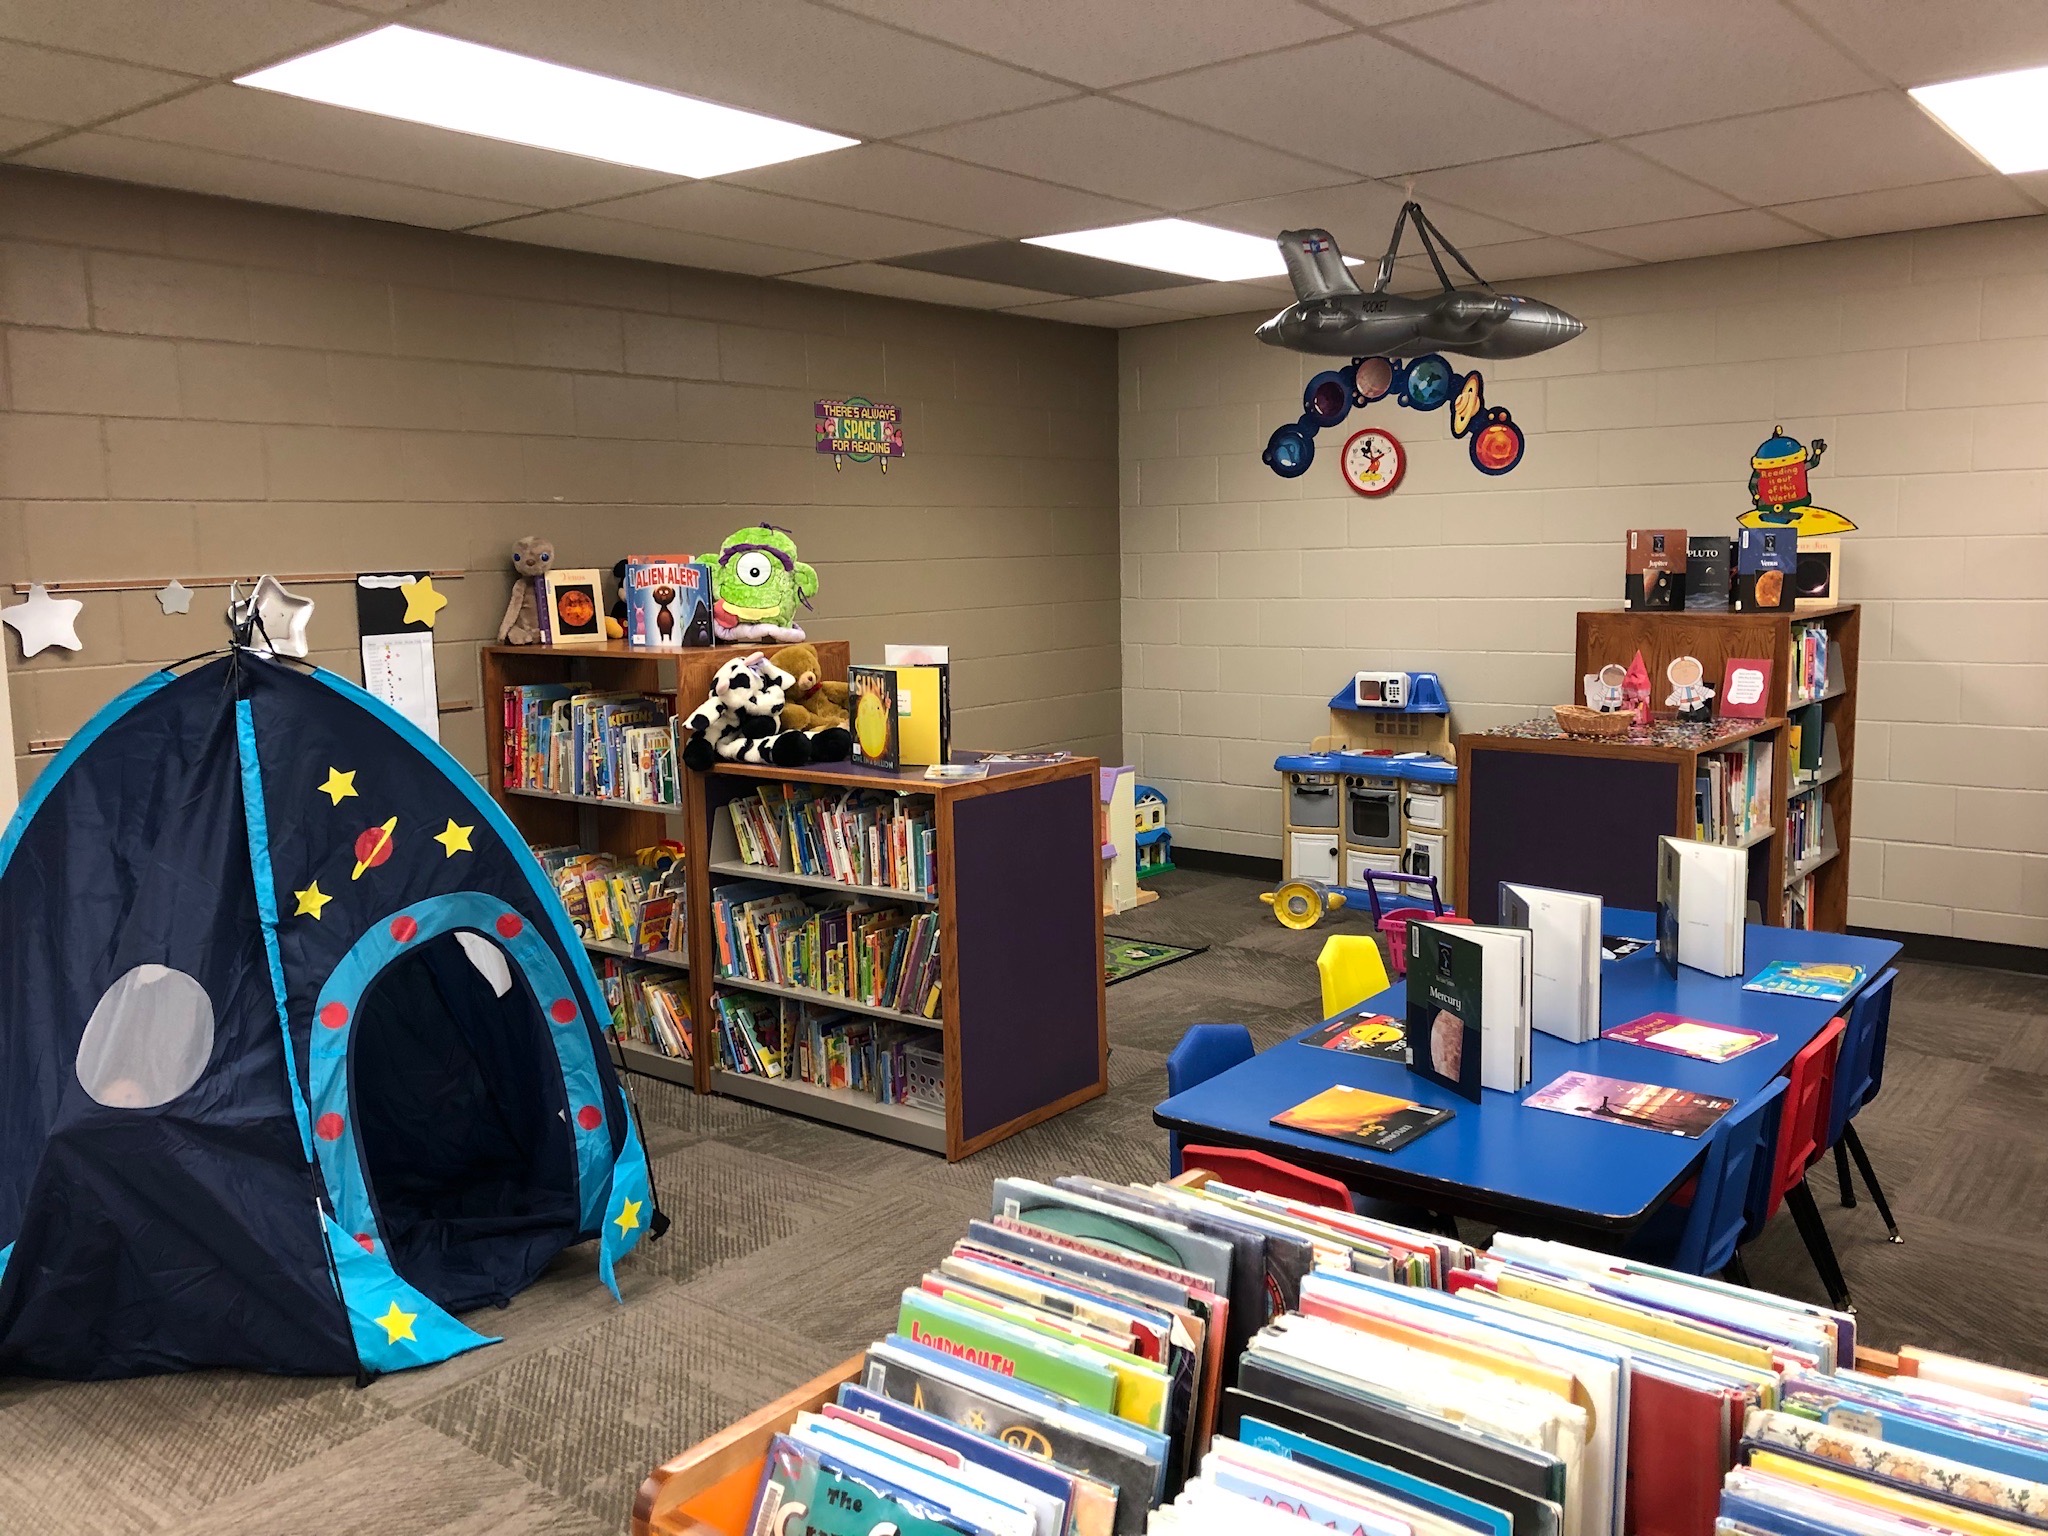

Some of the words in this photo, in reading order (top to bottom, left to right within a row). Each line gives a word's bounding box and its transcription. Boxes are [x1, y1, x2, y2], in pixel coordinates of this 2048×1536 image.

[823, 405, 860, 418] THERE'S
[861, 408, 896, 421] ALWAYS
[843, 419, 877, 440] SPACE
[832, 440, 850, 451] FOR
[851, 441, 891, 454] READING
[1761, 467, 1799, 478] Reading
[1776, 475, 1793, 484] out
[1768, 485, 1778, 494] of
[1779, 484, 1796, 493] this
[1768, 491, 1797, 502] World
[1687, 549, 1719, 558] PLUTO
[1648, 560, 1669, 568] Jupiter
[636, 567, 665, 589] ALIEN
[667, 567, 699, 588] ALERT
[855, 674, 885, 700] SUN!
[608, 710, 654, 728] KITTENS
[1429, 985, 1462, 1012] Mercury
[827, 1487, 864, 1513] The
